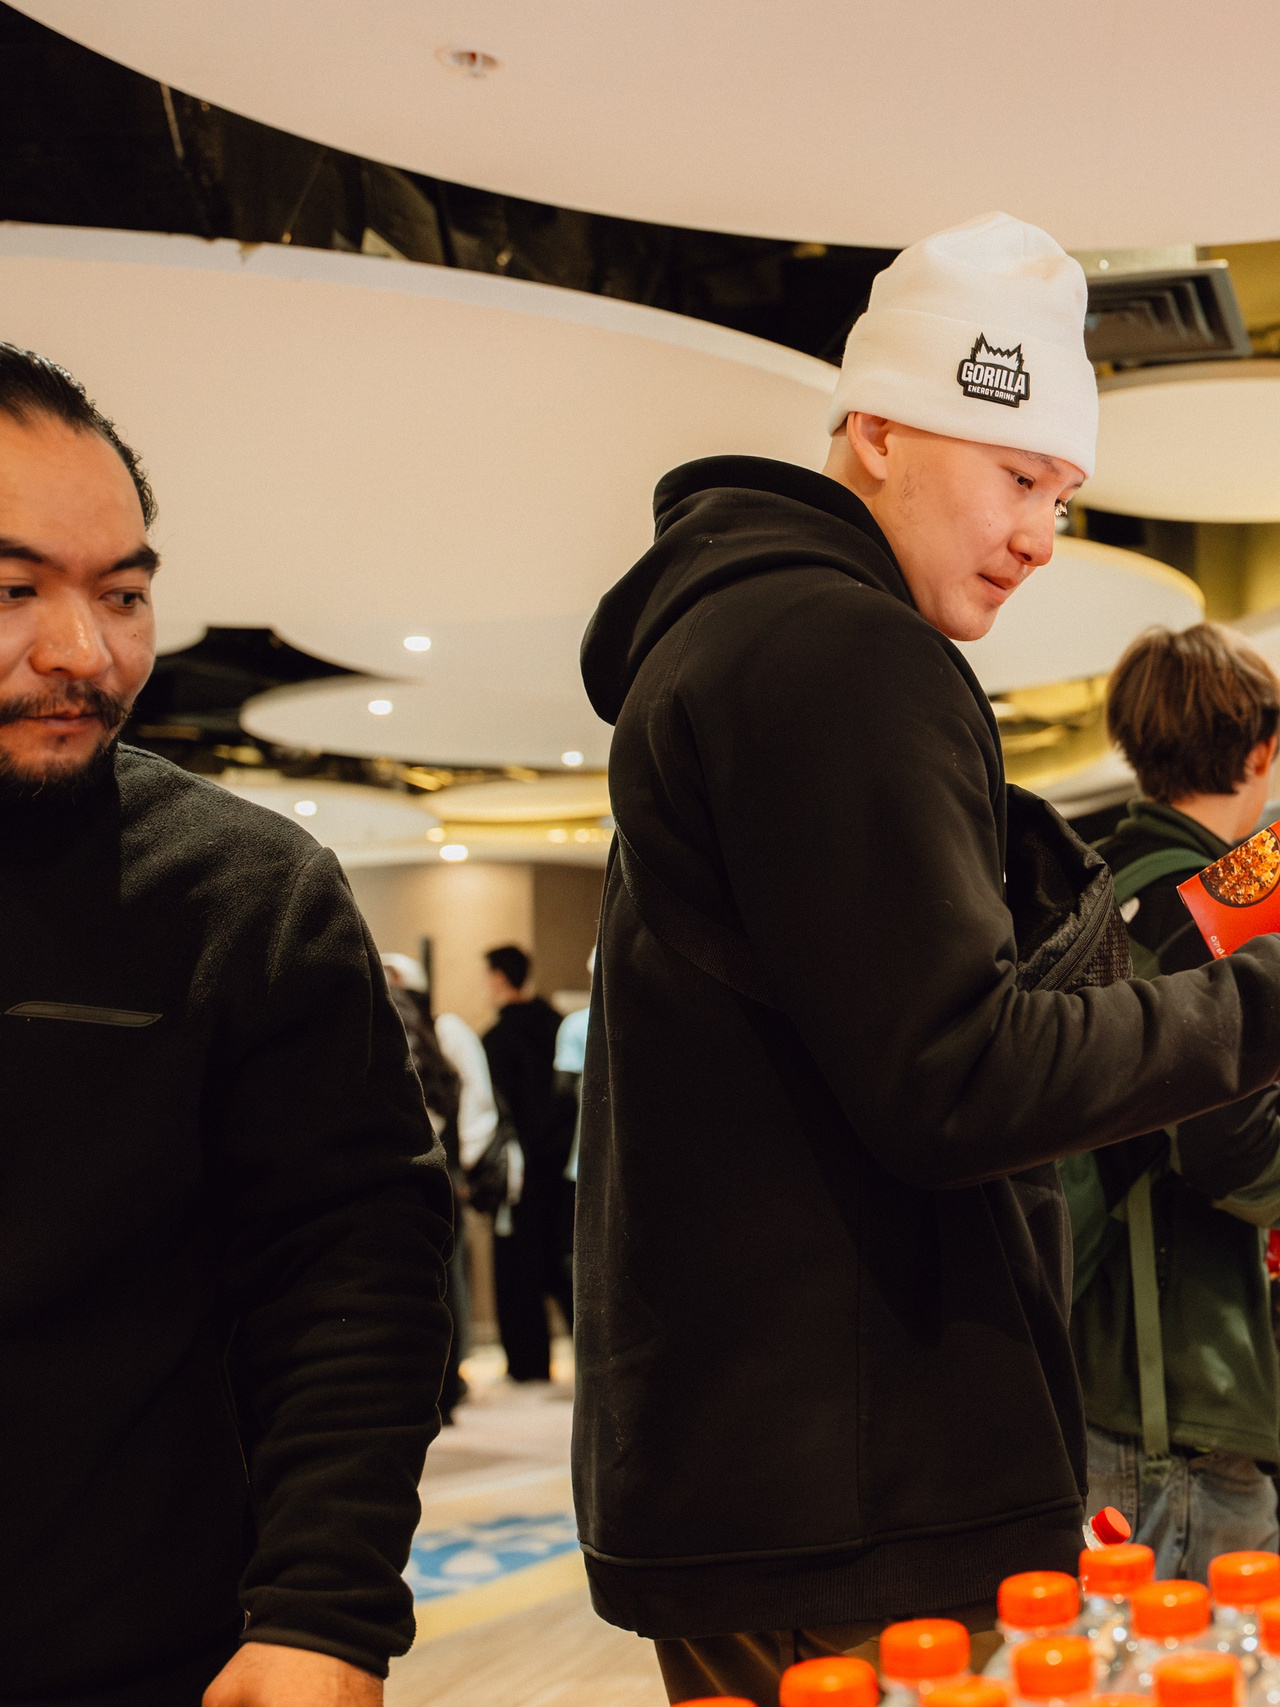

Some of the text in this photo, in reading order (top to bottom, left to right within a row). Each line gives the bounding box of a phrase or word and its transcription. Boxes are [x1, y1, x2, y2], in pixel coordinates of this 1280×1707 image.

[961, 362, 1026, 395] GORILLA
[968, 384, 1016, 402] ENERGY DRINK
